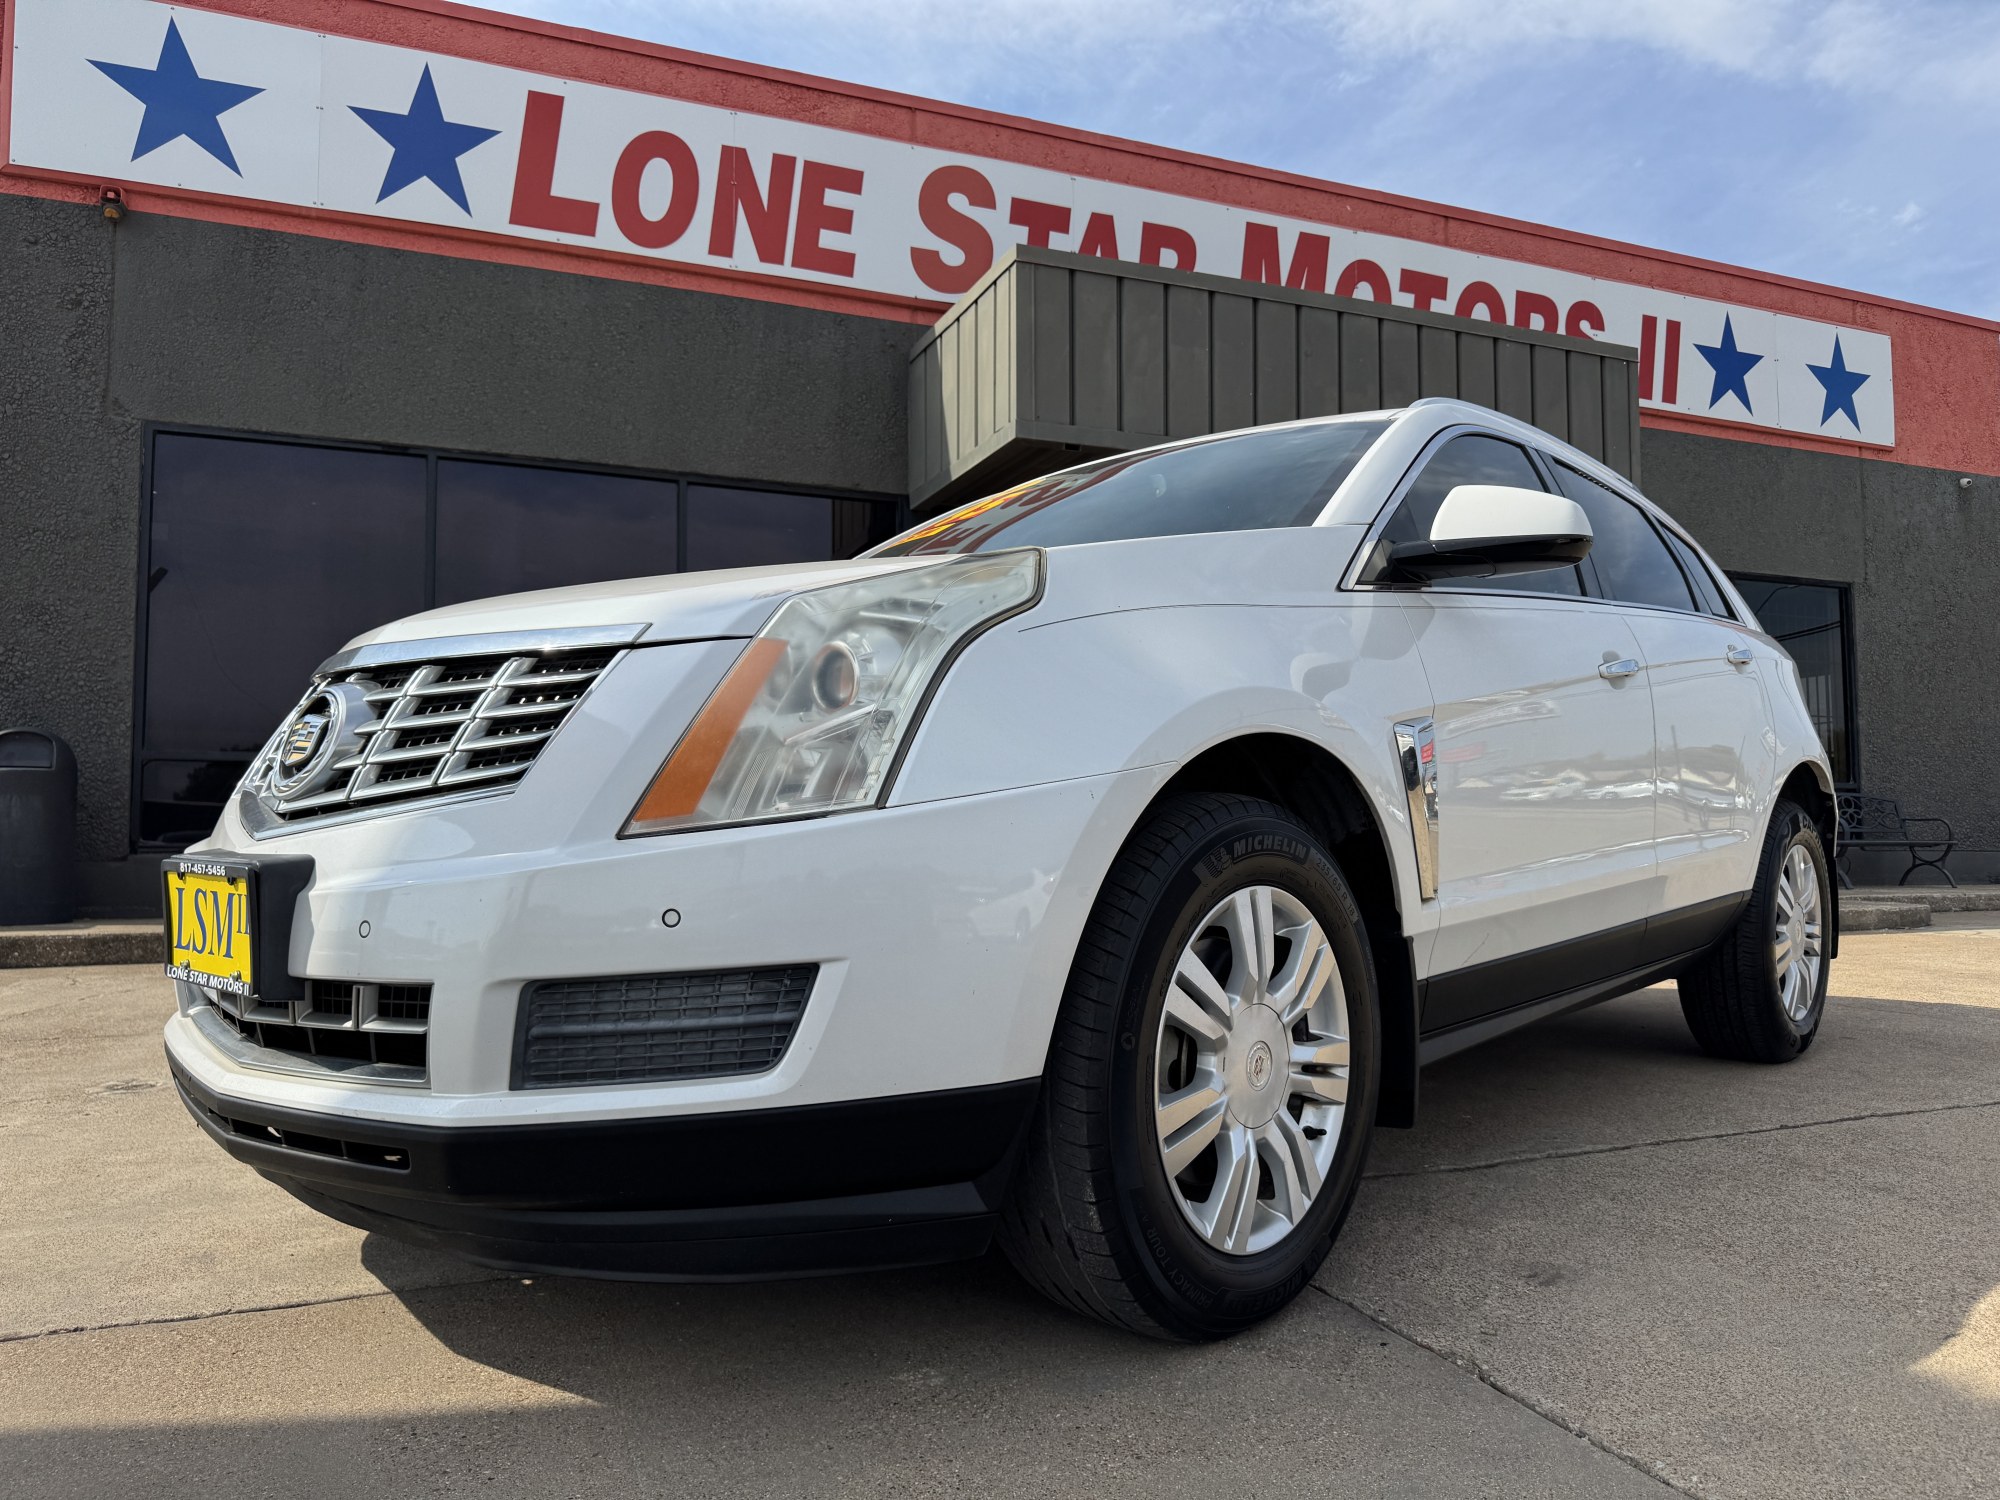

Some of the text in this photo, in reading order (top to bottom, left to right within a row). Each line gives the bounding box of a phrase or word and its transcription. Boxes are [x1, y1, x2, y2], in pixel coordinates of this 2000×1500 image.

[509, 90, 864, 278] LONE
[1638, 314, 1681, 405] II
[179, 862, 226, 876] 817-457-5456
[1233, 834, 1307, 860] MICHELIN
[1315, 856, 1356, 916] 235/65 R 18
[166, 965, 189, 980] LONE
[188, 971, 209, 986] STAR
[208, 976, 243, 994] MOTORS
[1146, 1226, 1214, 1308] PRIMACY TOUR
